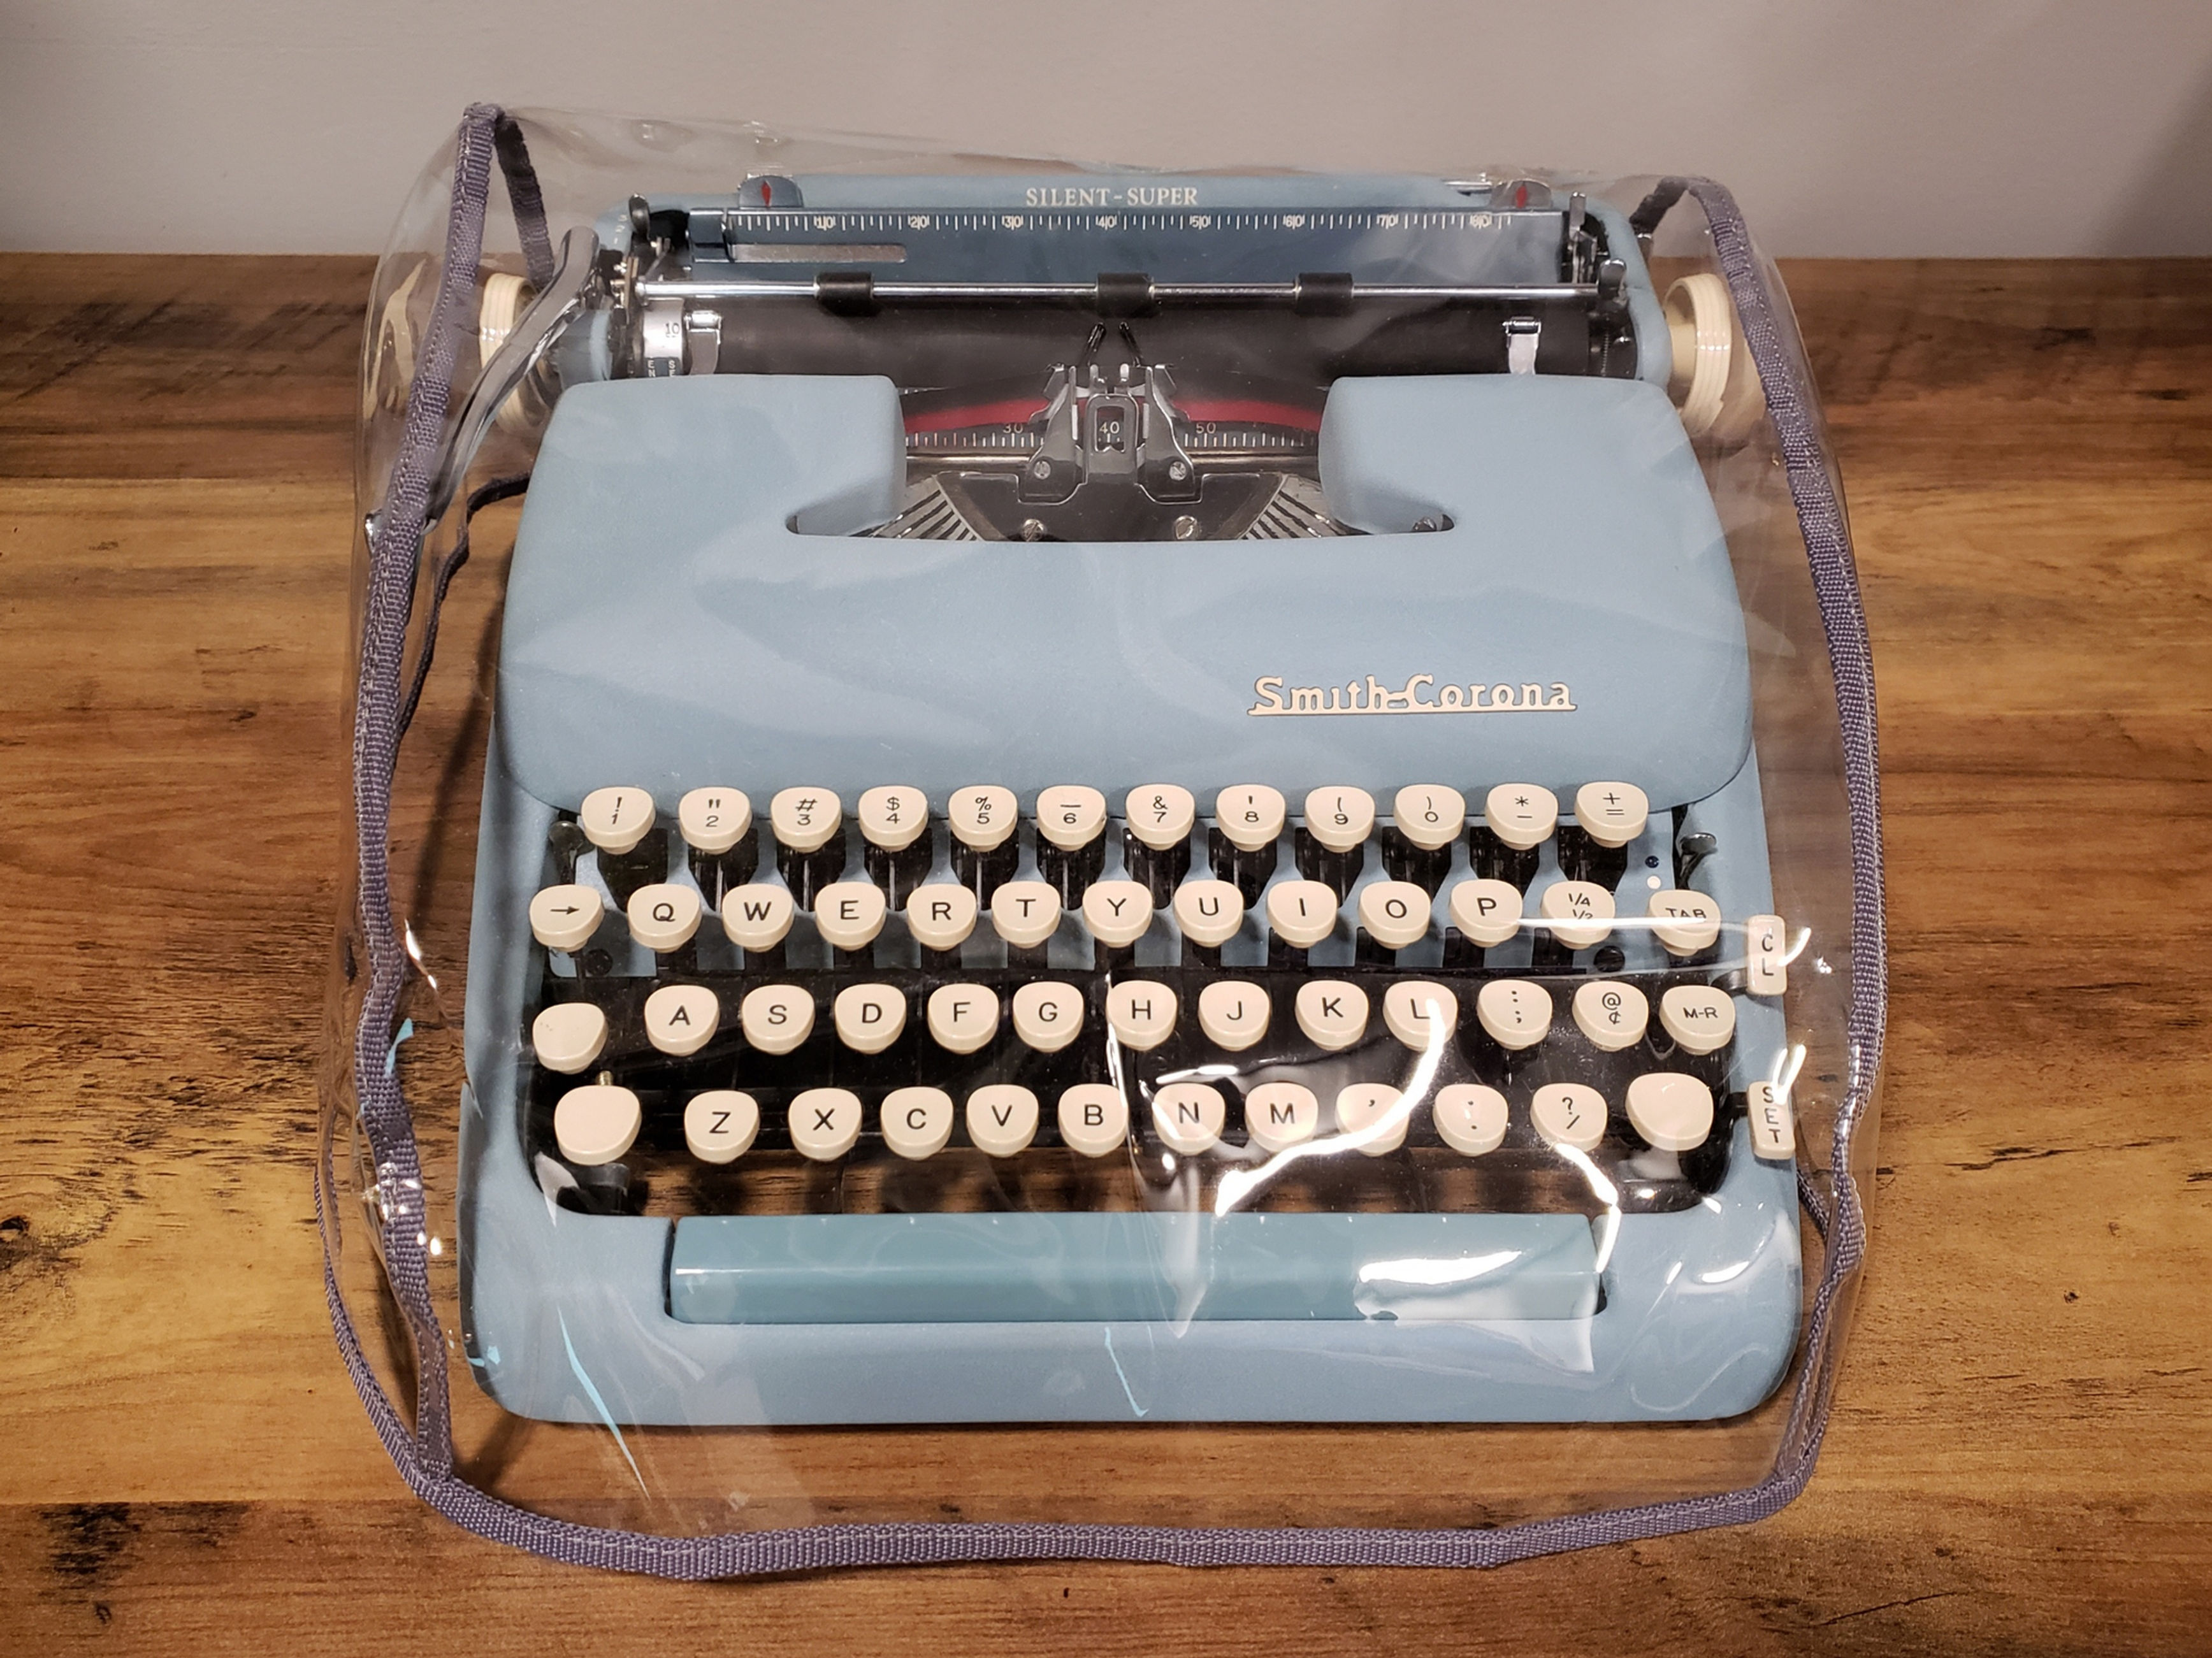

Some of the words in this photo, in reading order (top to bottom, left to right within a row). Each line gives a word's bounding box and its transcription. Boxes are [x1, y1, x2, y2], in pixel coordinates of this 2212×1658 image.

[816, 216, 834, 228] 10
[910, 216, 929, 228] 20
[1004, 215, 1021, 227] 30
[1097, 215, 1115, 227] 40
[1191, 215, 1210, 227] 50
[1285, 215, 1303, 227] 60
[1378, 215, 1398, 227] 70
[1471, 215, 1491, 227] 80
[665, 322, 680, 335] 10
[1002, 423, 1023, 434] 30
[1099, 421, 1120, 434] 40
[1196, 422, 1217, 434] 50
[1250, 674, 1573, 713] Smith-Corona
[615, 796, 623, 812] !
[796, 798, 818, 812] #
[886, 796, 900, 811] $
[975, 797, 992, 811] %
[1153, 796, 1168, 810] &
[1603, 793, 1620, 805] +
[612, 813, 618, 825] 1
[705, 815, 719, 827] 2
[797, 814, 811, 826] 3
[886, 812, 900, 824] 4
[976, 812, 990, 825] 5
[1063, 812, 1076, 824] 6
[1154, 811, 1167, 823] 7
[1245, 811, 1259, 823] 8
[1334, 813, 1348, 825] 9
[653, 903, 676, 923] Q
[744, 901, 772, 921] W
[840, 900, 860, 920] E
[932, 902, 951, 921] R
[1016, 898, 1036, 918] T
[1107, 898, 1127, 917] Y
[1199, 897, 1219, 916] U
[1299, 898, 1306, 917] I
[1385, 899, 1407, 919] O
[1477, 897, 1497, 916] P
[1665, 907, 1707, 919] TAB
[1131, 999, 1152, 1020] H
[1322, 997, 1343, 1018] K
[1410, 998, 1430, 1020] L
[1601, 991, 1621, 1011] @
[669, 1006, 691, 1026] A
[768, 1004, 787, 1025] S
[862, 1003, 883, 1024] D
[953, 1002, 971, 1023] F
[1038, 1002, 1058, 1022] G
[1226, 1001, 1243, 1021] J
[1608, 1011, 1621, 1025] ¢
[1683, 1007, 1718, 1018] M-R
[1084, 1104, 1104, 1126] B
[1178, 1102, 1199, 1123] N
[1269, 1103, 1294, 1124] M
[1562, 1097, 1573, 1115] ?
[709, 1111, 731, 1134] Z
[813, 1109, 835, 1130] X
[906, 1108, 927, 1130] C
[992, 1105, 1013, 1127] V
